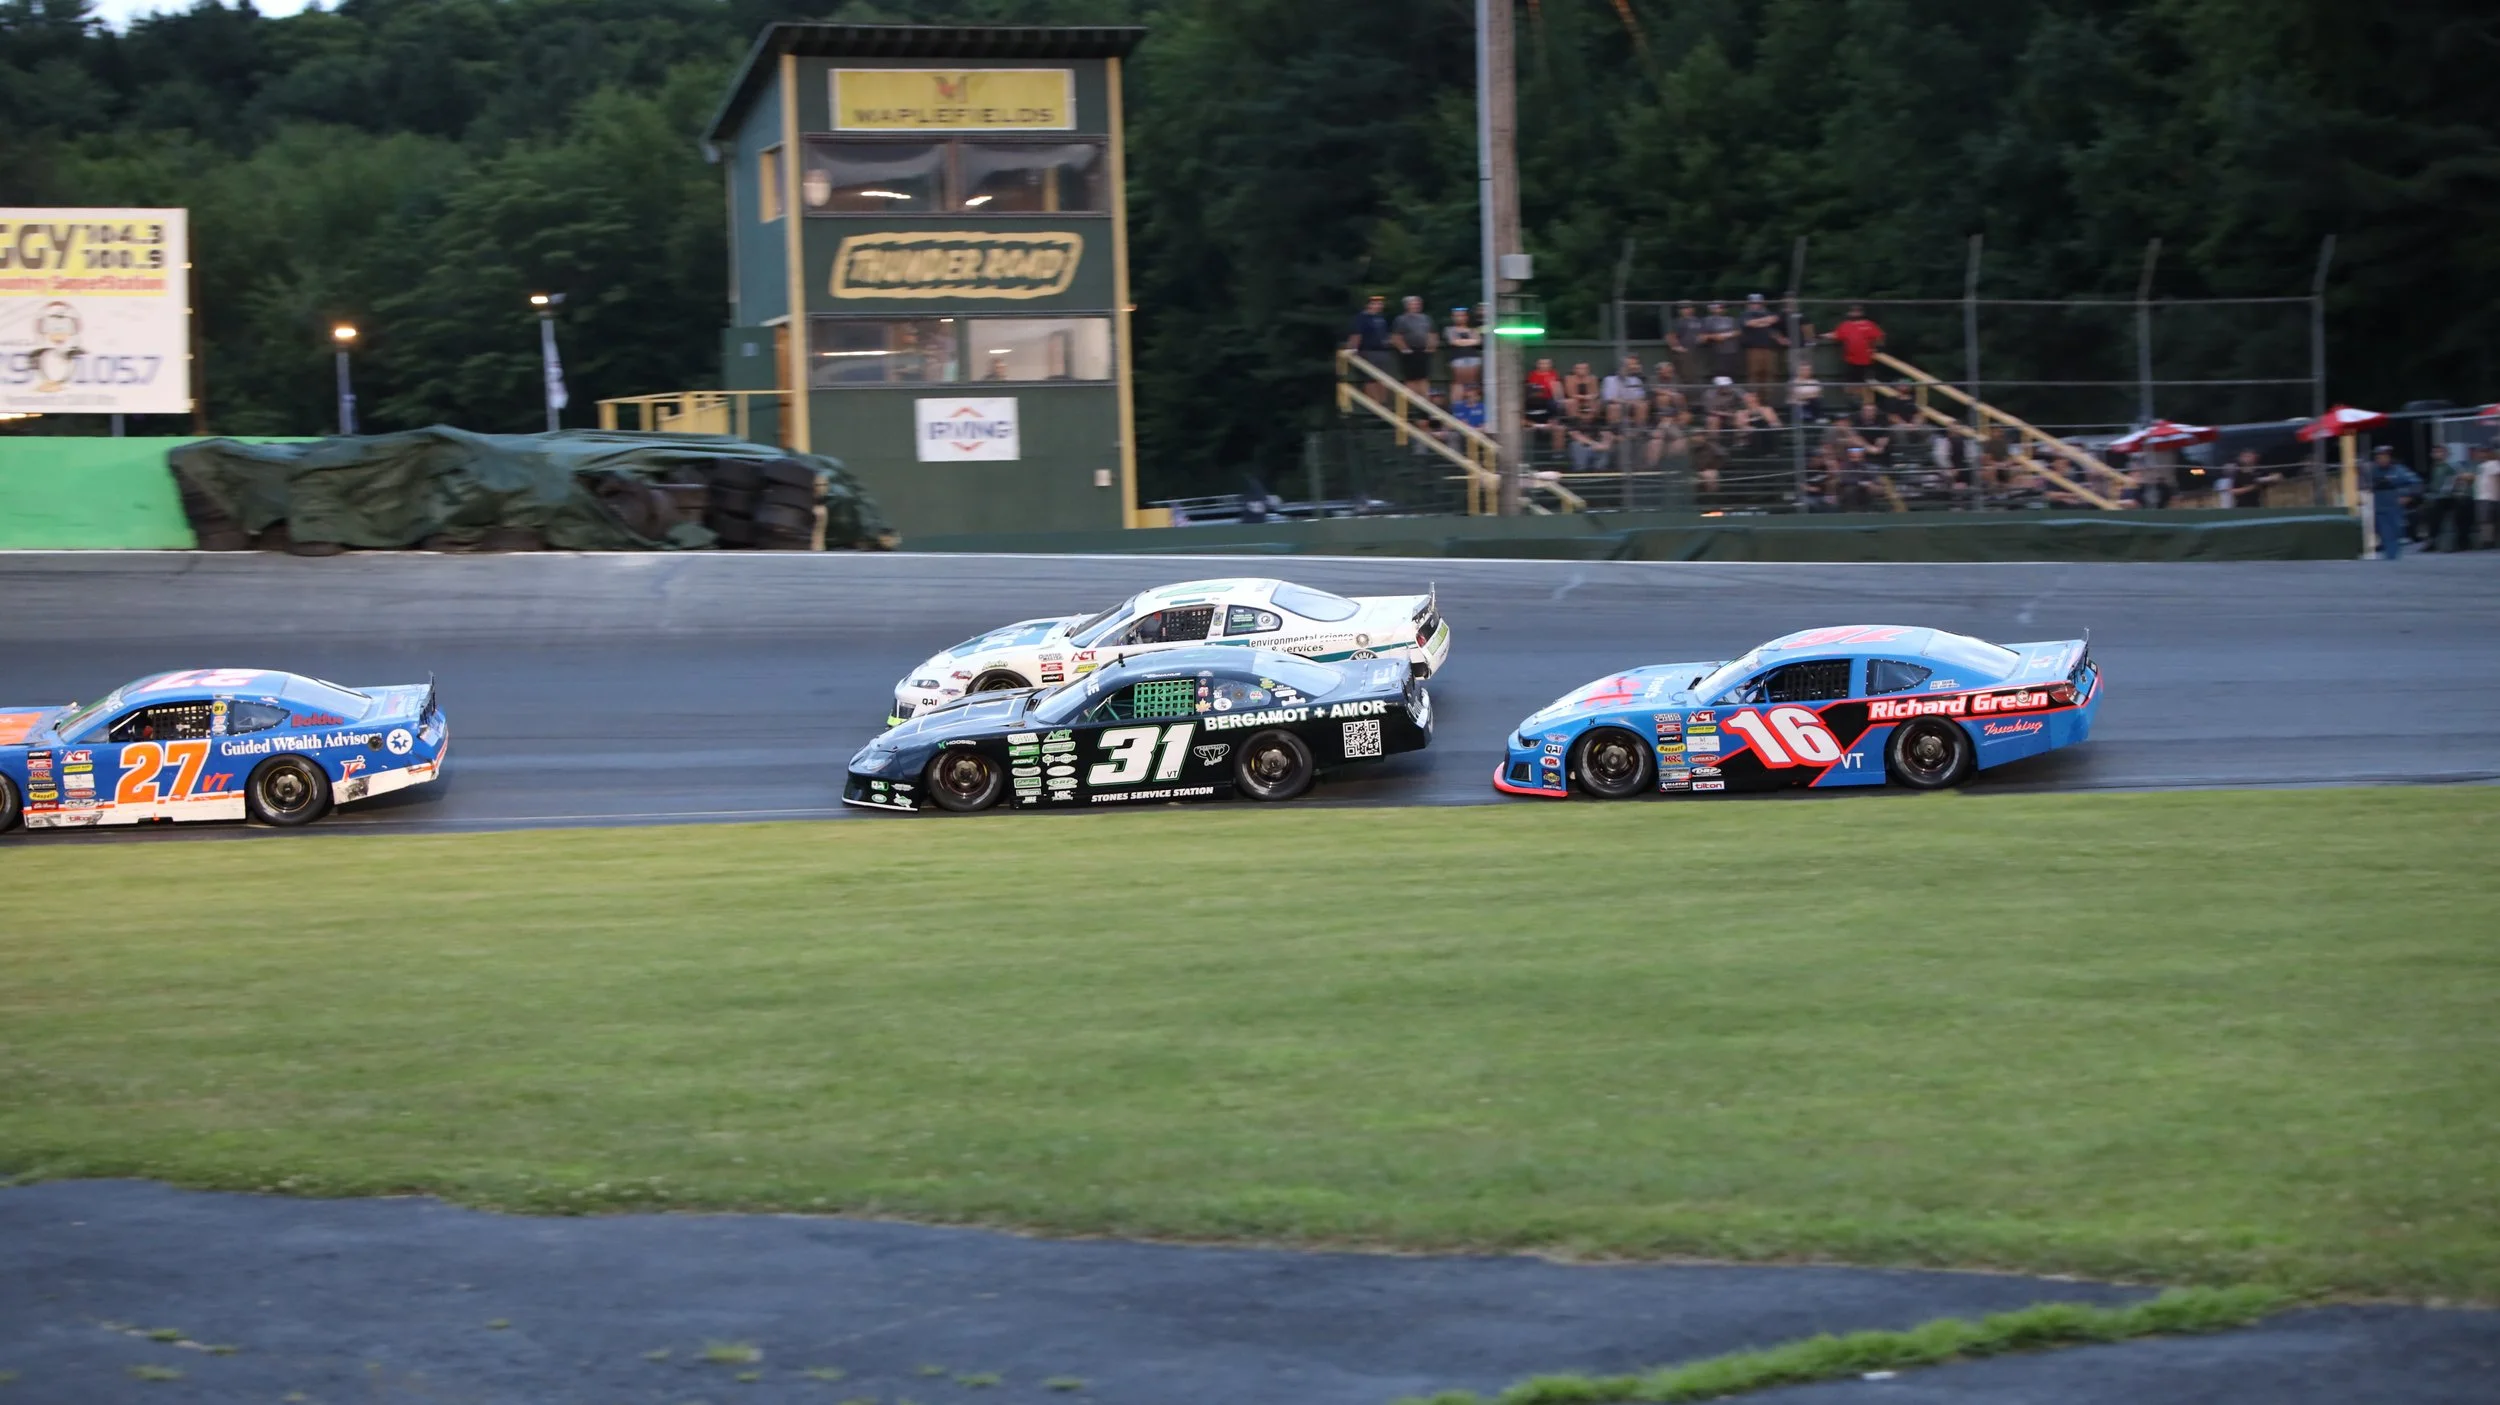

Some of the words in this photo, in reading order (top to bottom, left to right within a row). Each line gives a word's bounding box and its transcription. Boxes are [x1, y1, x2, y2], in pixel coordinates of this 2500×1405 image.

[854, 108, 1054, 123] MAPLEFIELDS
[849, 249, 983, 283] THUNDER
[984, 249, 1066, 280] ROAD
[928, 420, 1012, 440] IRVING
[1071, 650, 1097, 662] ACT
[1204, 707, 1309, 731] BERGAMOT
[1330, 700, 1387, 718] AMOR
[1687, 711, 1716, 724] ACT
[1868, 695, 1967, 720] Richard
[1044, 729, 1072, 742] ACT
[1721, 705, 1843, 768] 16
[1984, 719, 2043, 736] Trucking
[221, 741, 271, 756] Guided
[272, 734, 322, 751] Wealth
[1087, 722, 1197, 786] 31
[61, 749, 93, 763] ACT
[1840, 753, 1864, 769] VT
[115, 739, 212, 805] 27
[202, 772, 234, 793] VT
[1091, 793, 1128, 802] STONES
[1130, 790, 1171, 799] SERVICE
[1173, 787, 1214, 796] STATION
